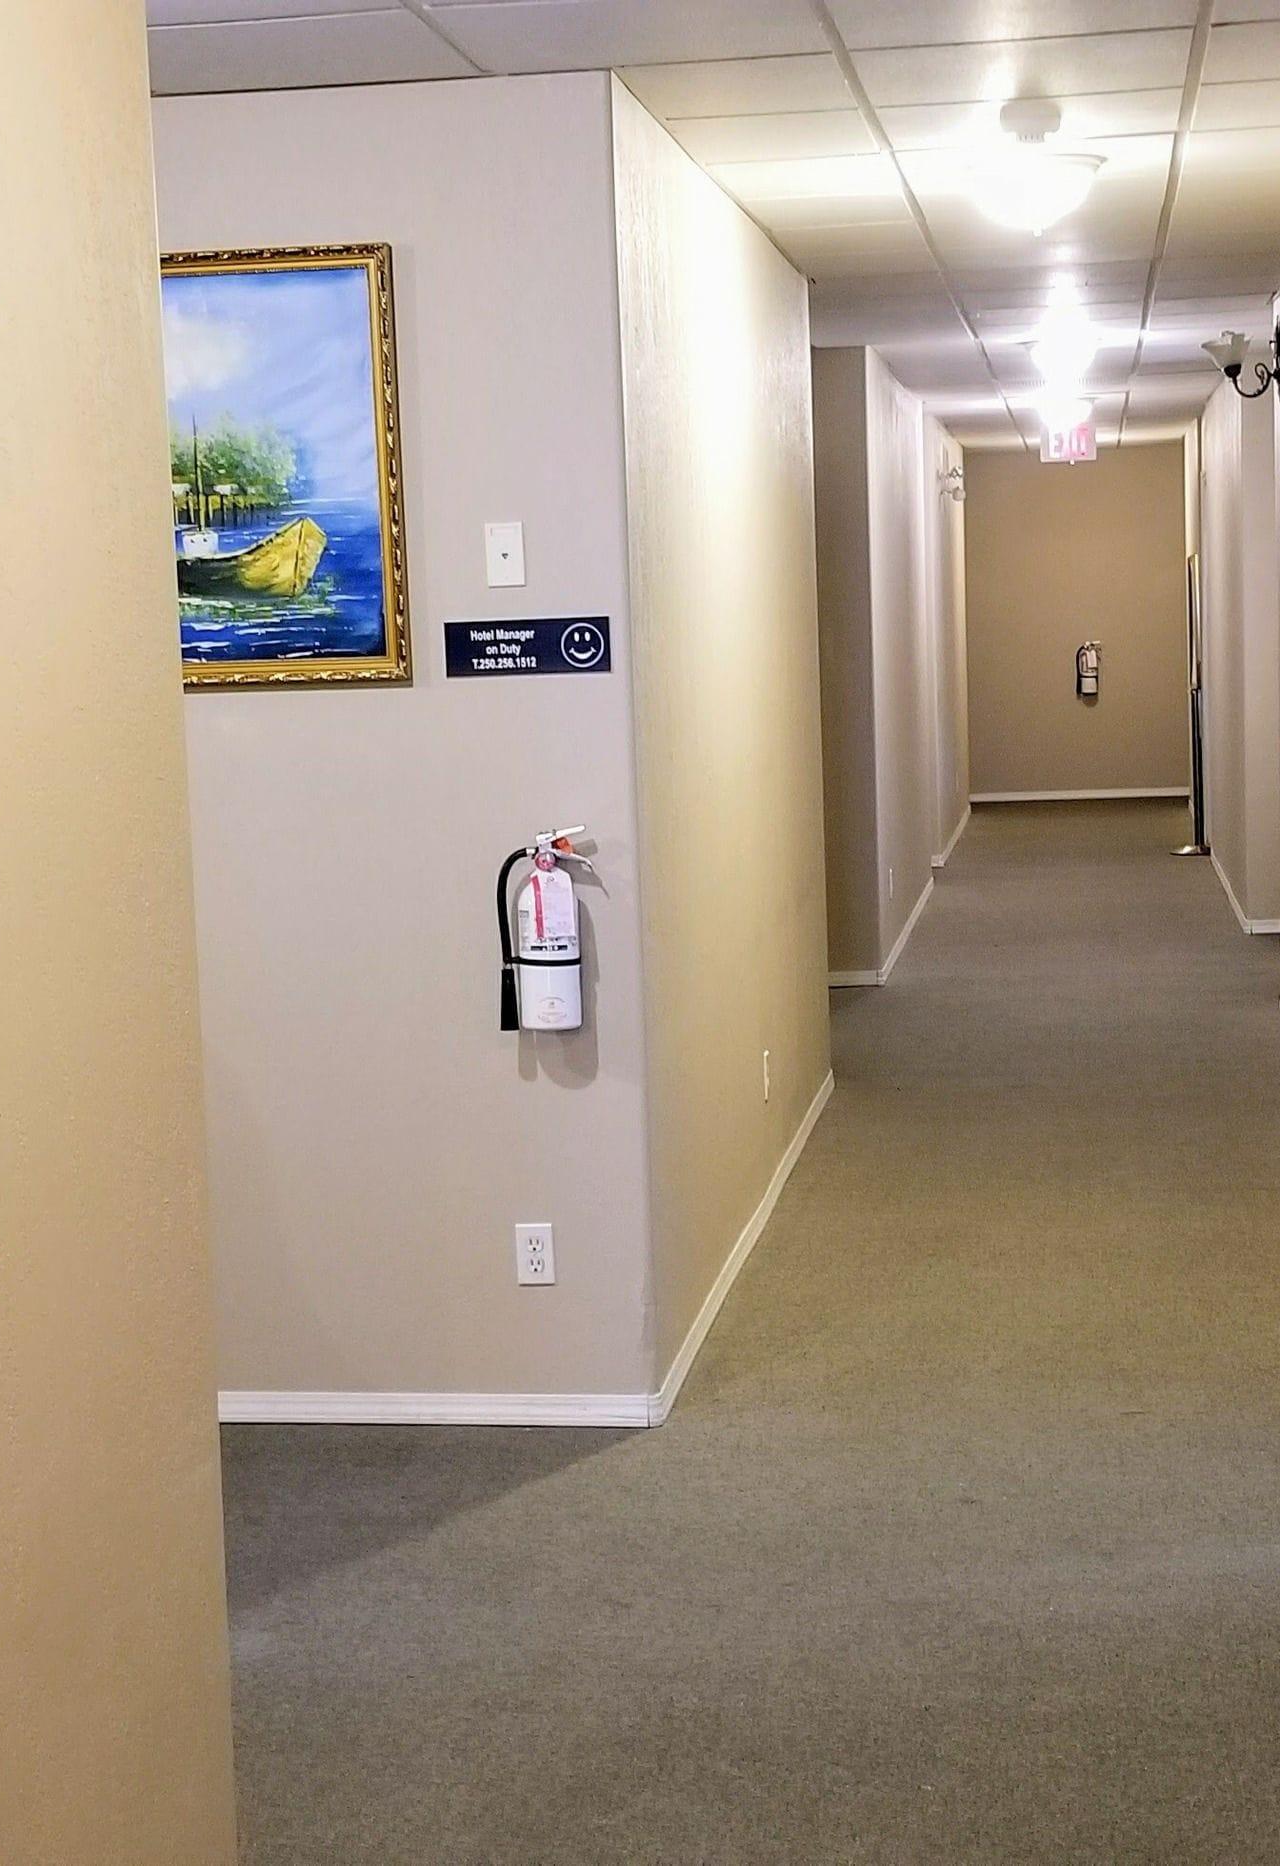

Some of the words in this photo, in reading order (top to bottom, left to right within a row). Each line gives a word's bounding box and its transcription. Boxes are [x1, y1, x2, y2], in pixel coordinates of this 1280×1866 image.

[470, 629, 494, 642] Hotel
[496, 629, 535, 642] Manager
[485, 645, 498, 655] on
[499, 643, 521, 656] Duty
